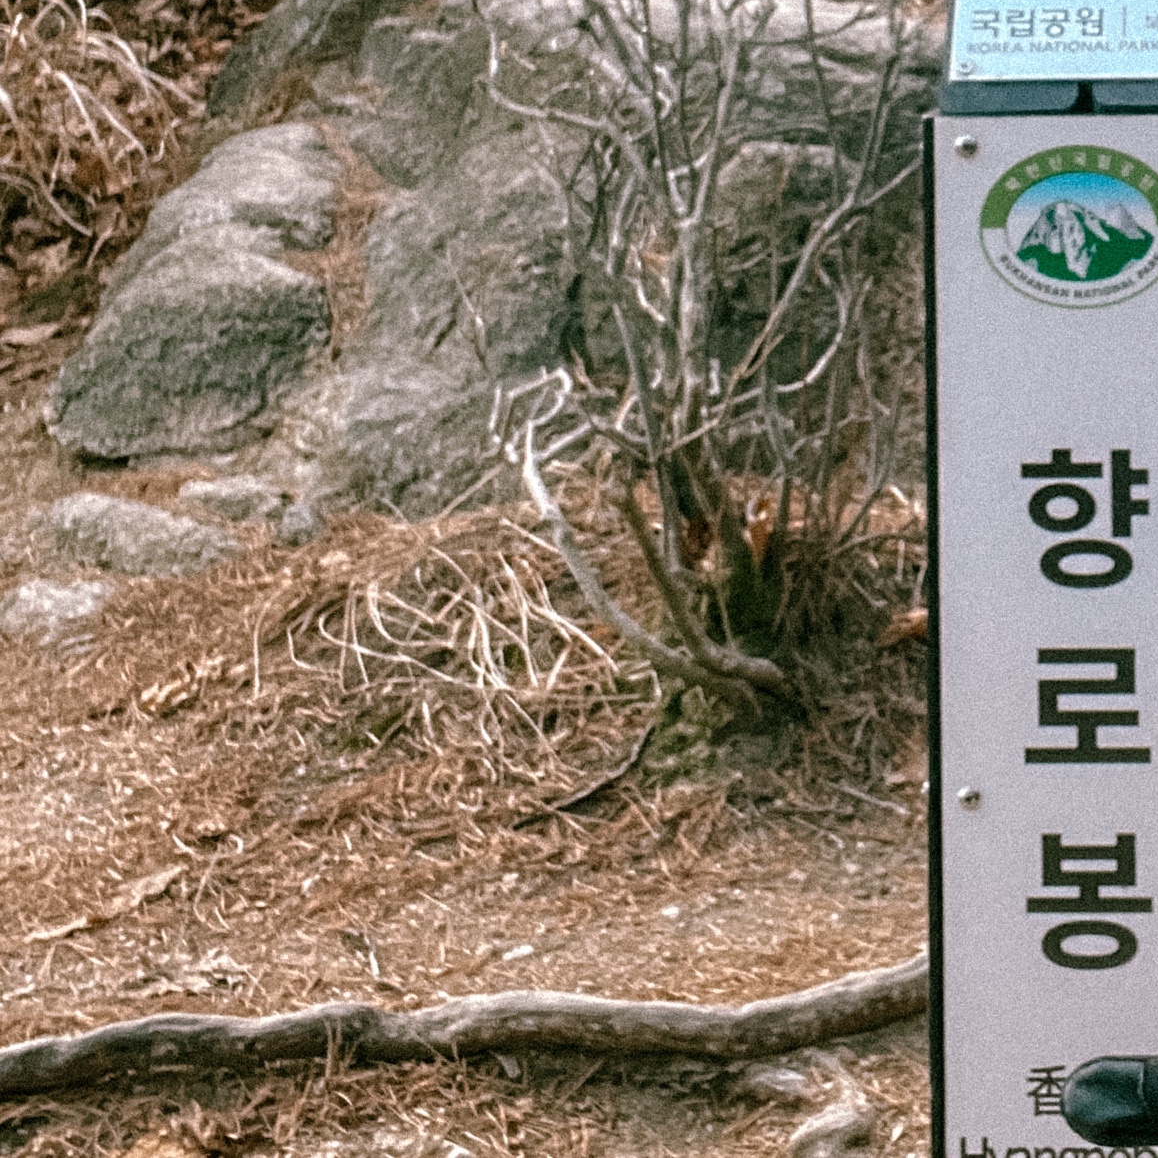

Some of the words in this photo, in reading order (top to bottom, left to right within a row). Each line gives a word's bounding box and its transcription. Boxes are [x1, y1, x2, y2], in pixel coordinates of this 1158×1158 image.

[972, 6, 1105, 39] 국립공원
[966, 42, 1024, 55] KOREA
[1029, 41, 1113, 54] NATIONAL
[1020, 448, 1154, 970] 향로봉
